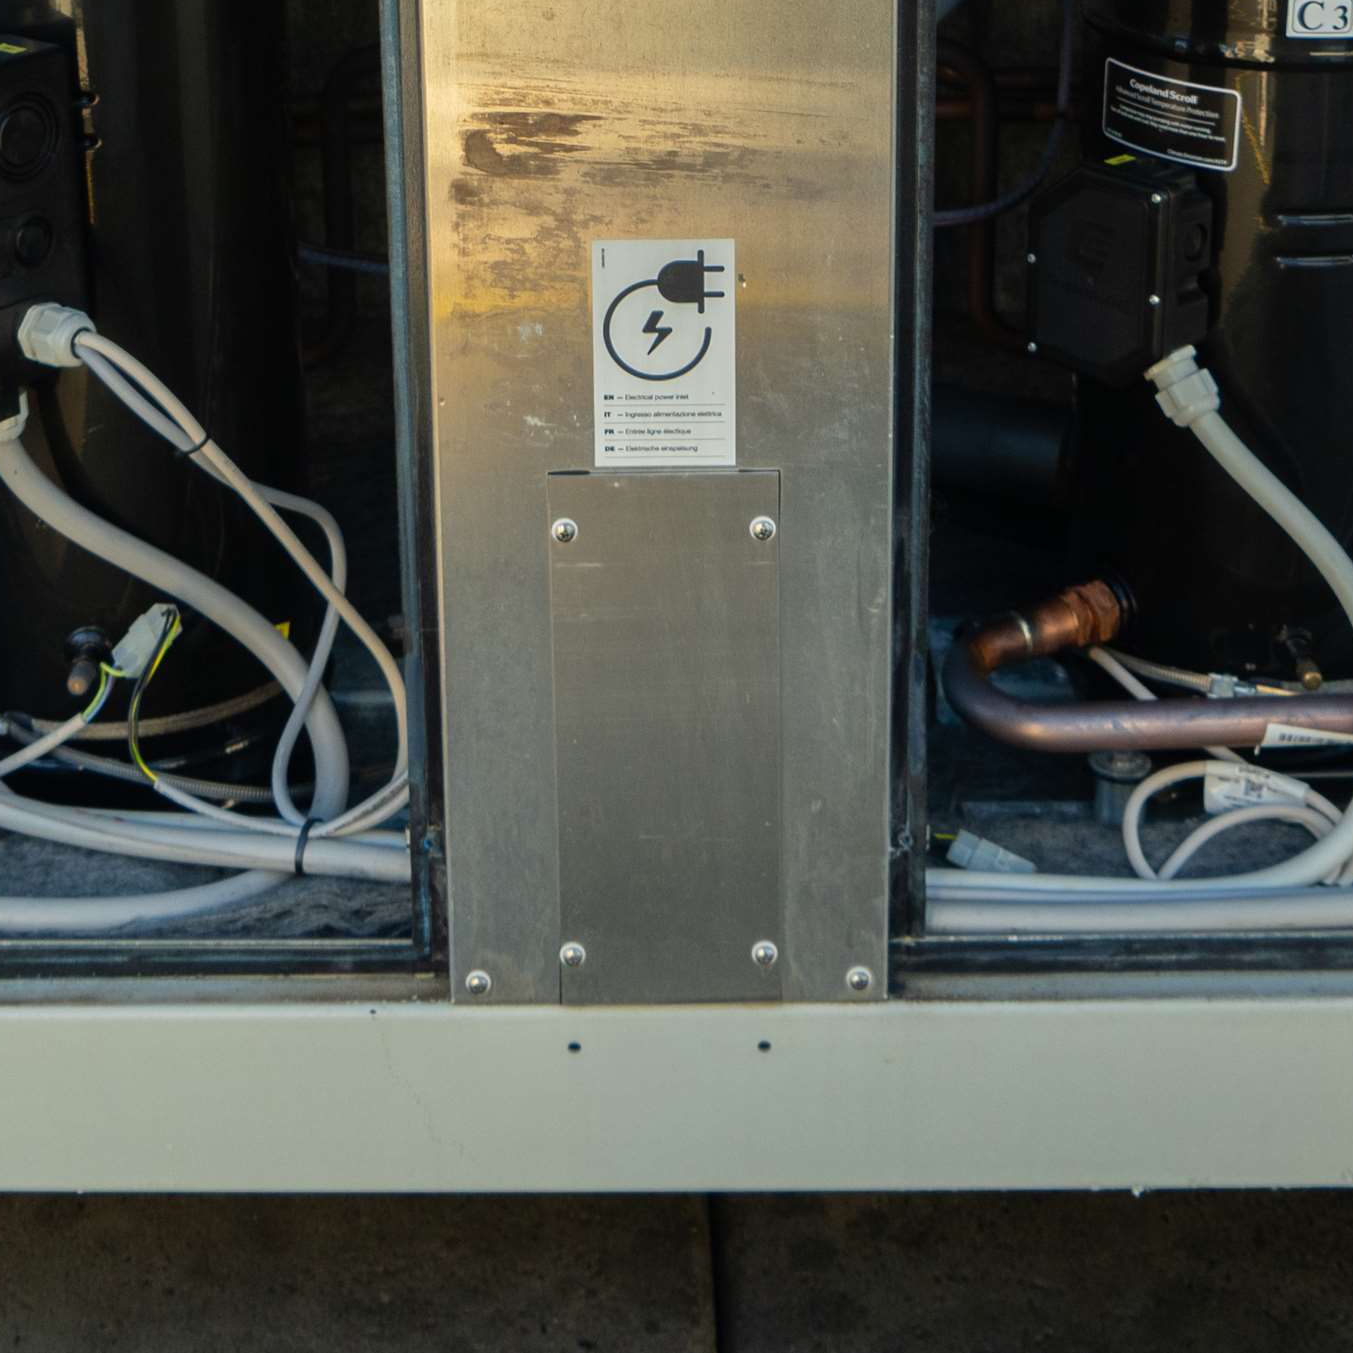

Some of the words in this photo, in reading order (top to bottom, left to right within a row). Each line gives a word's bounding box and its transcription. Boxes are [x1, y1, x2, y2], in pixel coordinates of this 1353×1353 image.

[1129, 79, 1168, 98] Copeland
[1168, 91, 1198, 105] Scroll
[654, 394, 674, 402] power
[625, 411, 652, 419] Ingresso
[647, 428, 662, 436] ligne
